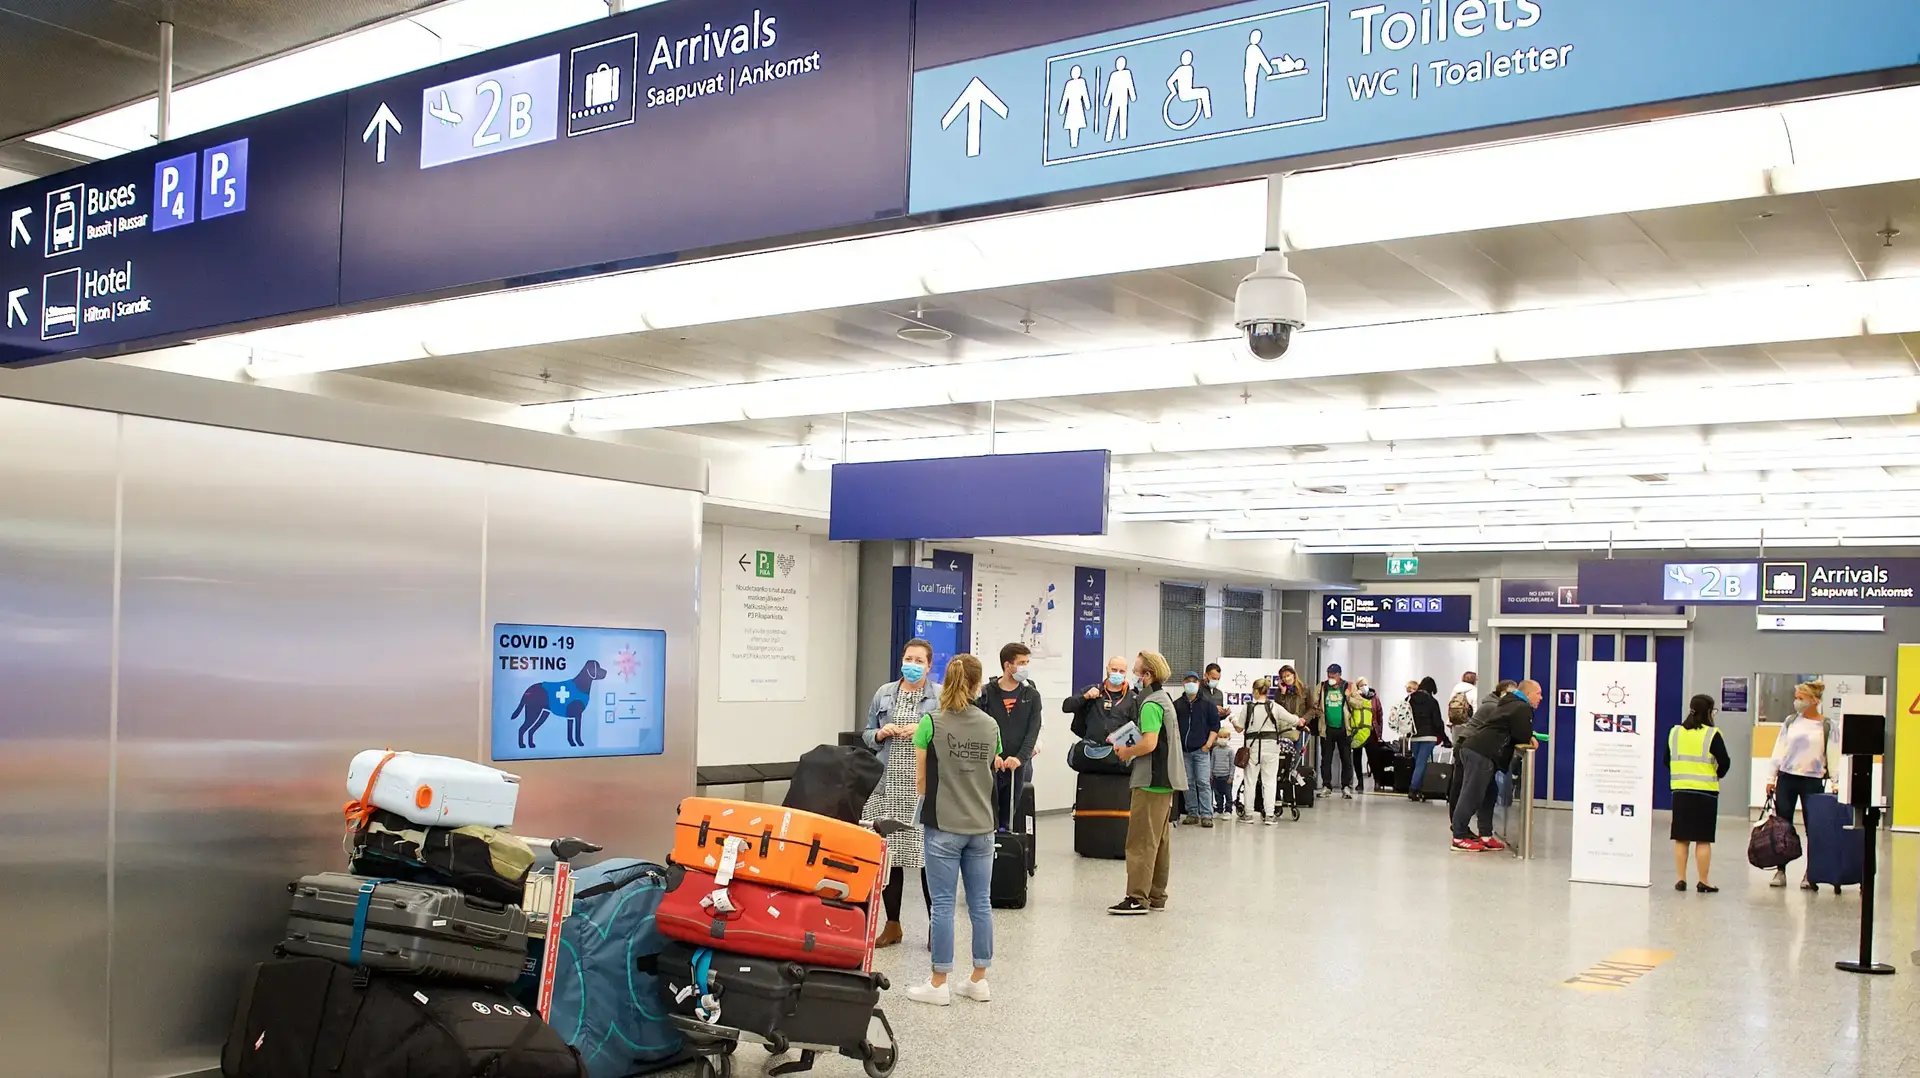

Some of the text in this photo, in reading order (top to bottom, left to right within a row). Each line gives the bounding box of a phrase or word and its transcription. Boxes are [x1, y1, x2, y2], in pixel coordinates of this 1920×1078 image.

[647, 9, 777, 75] Arrivals
[1349, 0, 1542, 56] Toilets
[646, 50, 821, 108] Saapuvat Ankomst
[1347, 43, 1574, 101] WC Toaletter
[161, 166, 185, 220] P4
[210, 152, 237, 208] P5
[87, 183, 136, 216] Buses
[86, 213, 148, 240] Bussit Bussar
[84, 260, 132, 299] Hotel
[83, 296, 152, 323] Hilton Scandic
[917, 582, 956, 595] Local Traffic
[1812, 566, 1888, 583] Arrivals
[1811, 586, 1913, 599] Saapuvat Ankomst
[1356, 615, 1374, 624] Hotel
[499, 634, 575, 650] COVID -19
[499, 656, 567, 671] TESTING
[949, 750, 989, 760] NOSE
[1562, 959, 1656, 988] TAXI
